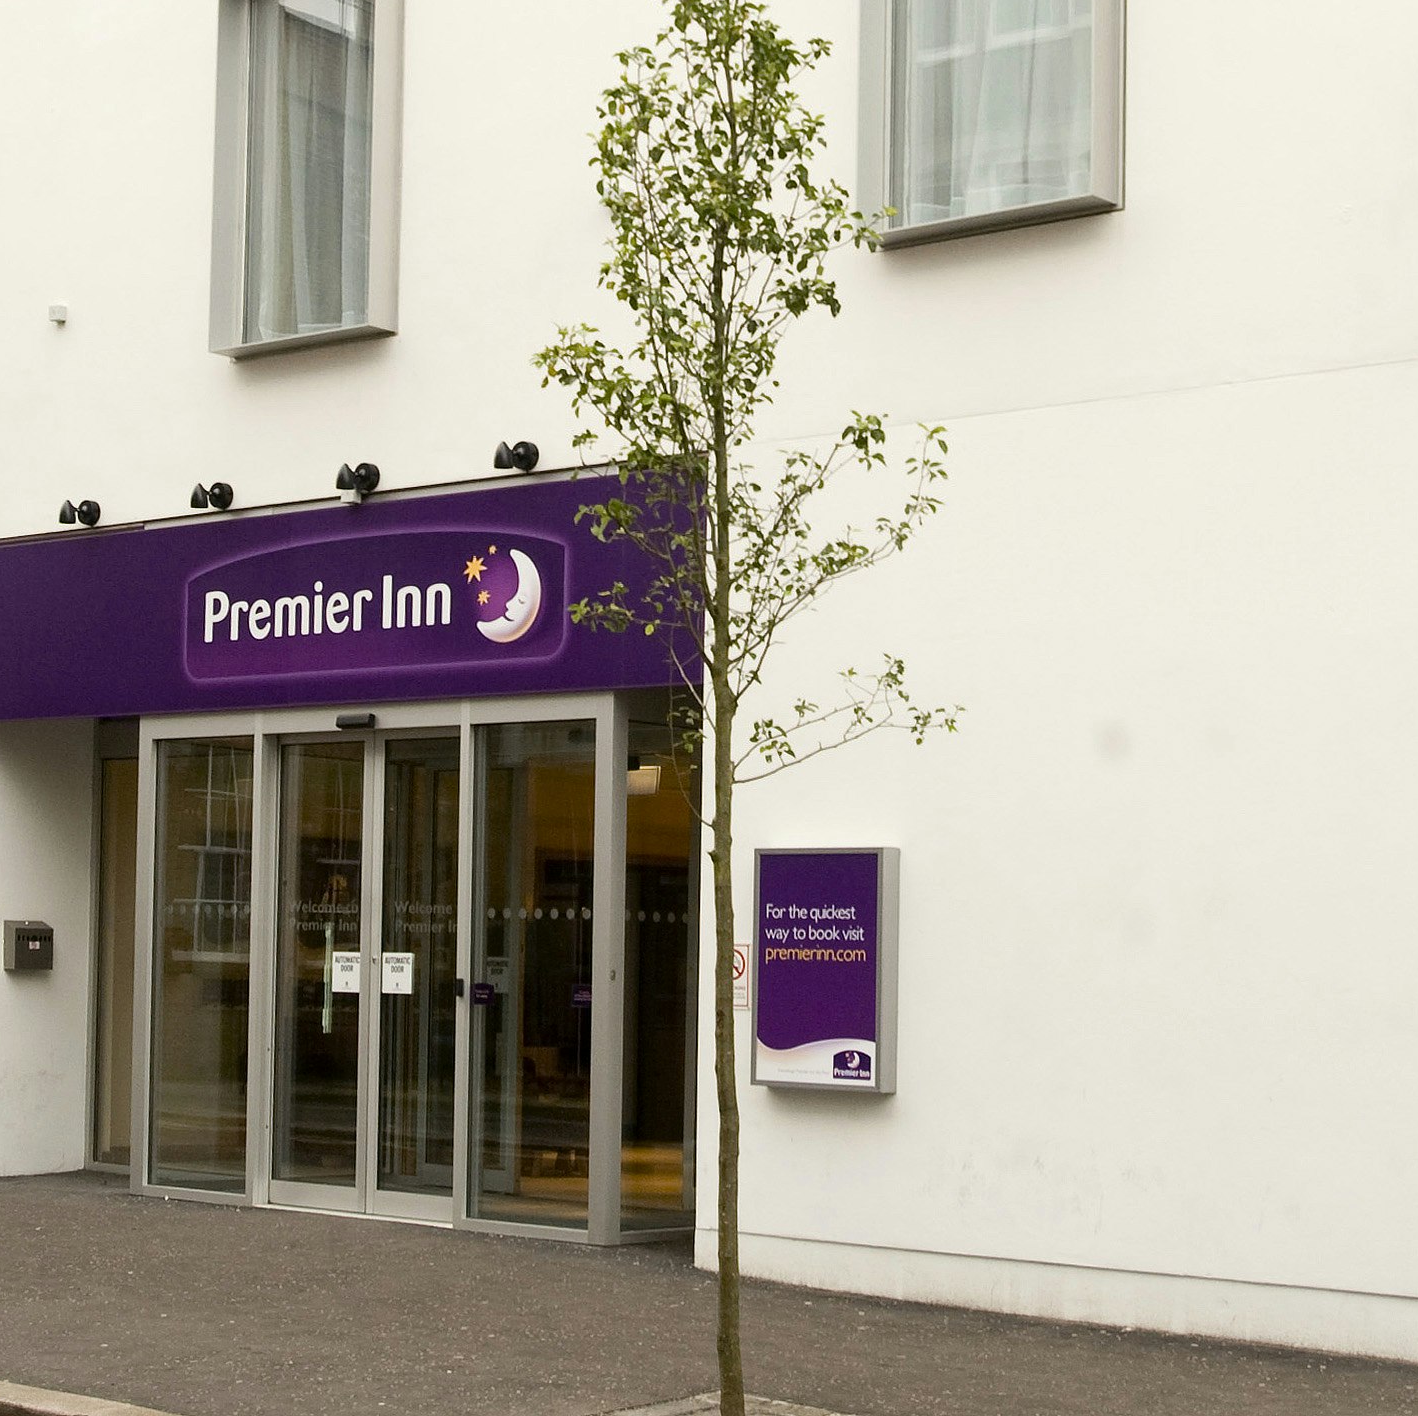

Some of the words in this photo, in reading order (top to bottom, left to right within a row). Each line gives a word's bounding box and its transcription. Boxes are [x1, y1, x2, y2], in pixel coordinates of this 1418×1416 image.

[204, 581, 373, 644] Premier
[382, 575, 452, 630] Inn
[394, 900, 453, 915] Welcome
[765, 903, 786, 920] For
[788, 903, 808, 920] the
[810, 904, 856, 923] quickest
[765, 927, 790, 944] way
[792, 926, 806, 941] to
[808, 925, 841, 941] book
[842, 925, 865, 941] visit
[765, 944, 867, 965] premierinn.com
[340, 964, 354, 972] DOOR
[390, 965, 405, 973] DOOR
[834, 1067, 859, 1077] Premier
